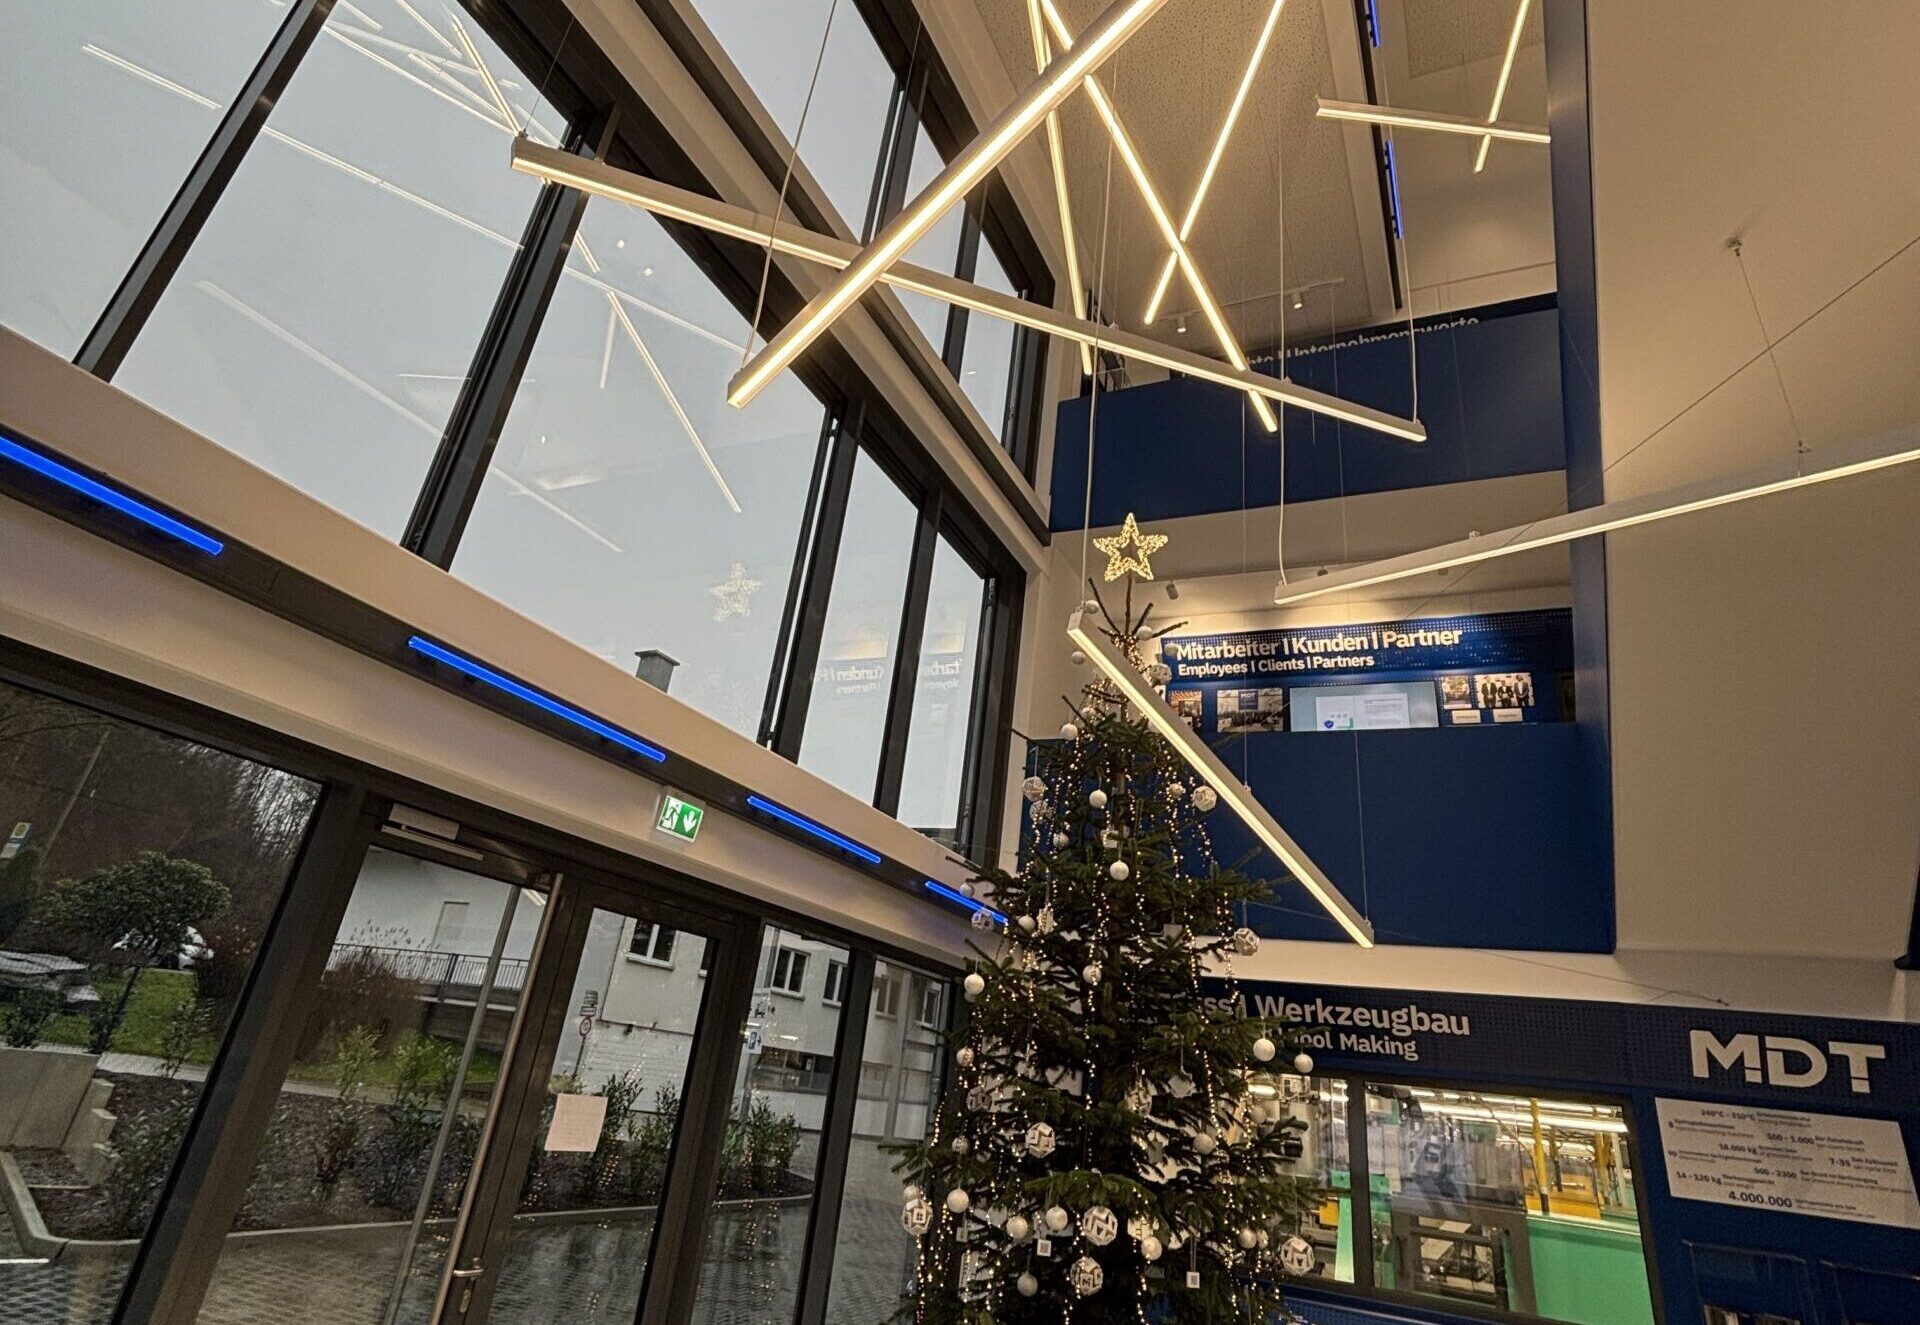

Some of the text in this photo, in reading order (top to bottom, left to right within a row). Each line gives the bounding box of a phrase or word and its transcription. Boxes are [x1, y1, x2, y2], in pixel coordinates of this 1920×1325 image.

[1176, 638, 1279, 661] Mitarbeiter
[1292, 633, 1369, 654] Kunden
[1382, 629, 1463, 649] Partner
[1178, 662, 1249, 678] Employees
[1258, 658, 1304, 673] Clients
[1314, 654, 1375, 669] Partners
[1254, 994, 1470, 1036] Werkzeugbau
[1340, 1033, 1420, 1061] Making
[1690, 1029, 1886, 1094] MDT
[1728, 1190, 1793, 1207] 4.000.000
